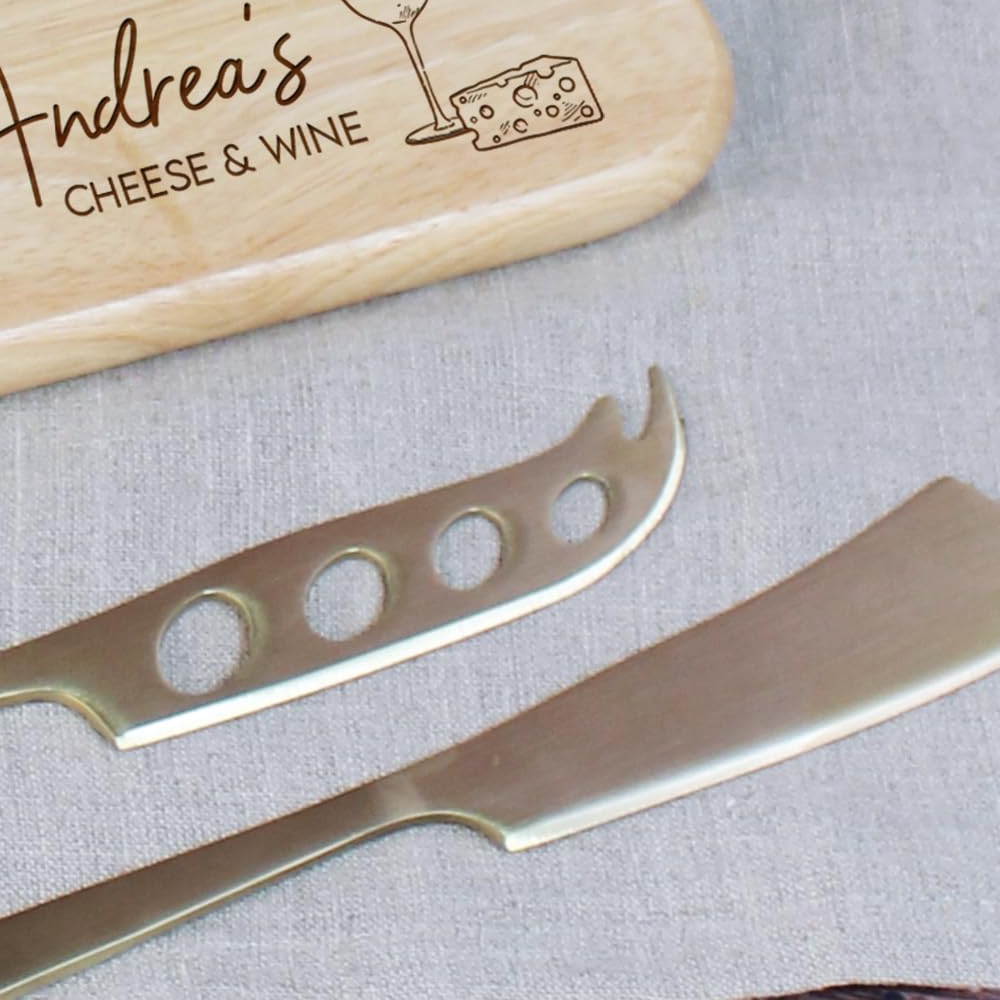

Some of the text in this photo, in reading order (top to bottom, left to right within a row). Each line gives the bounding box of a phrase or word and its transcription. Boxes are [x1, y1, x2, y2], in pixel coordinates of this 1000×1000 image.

[64, 110, 369, 217] CHEESE & WINE
